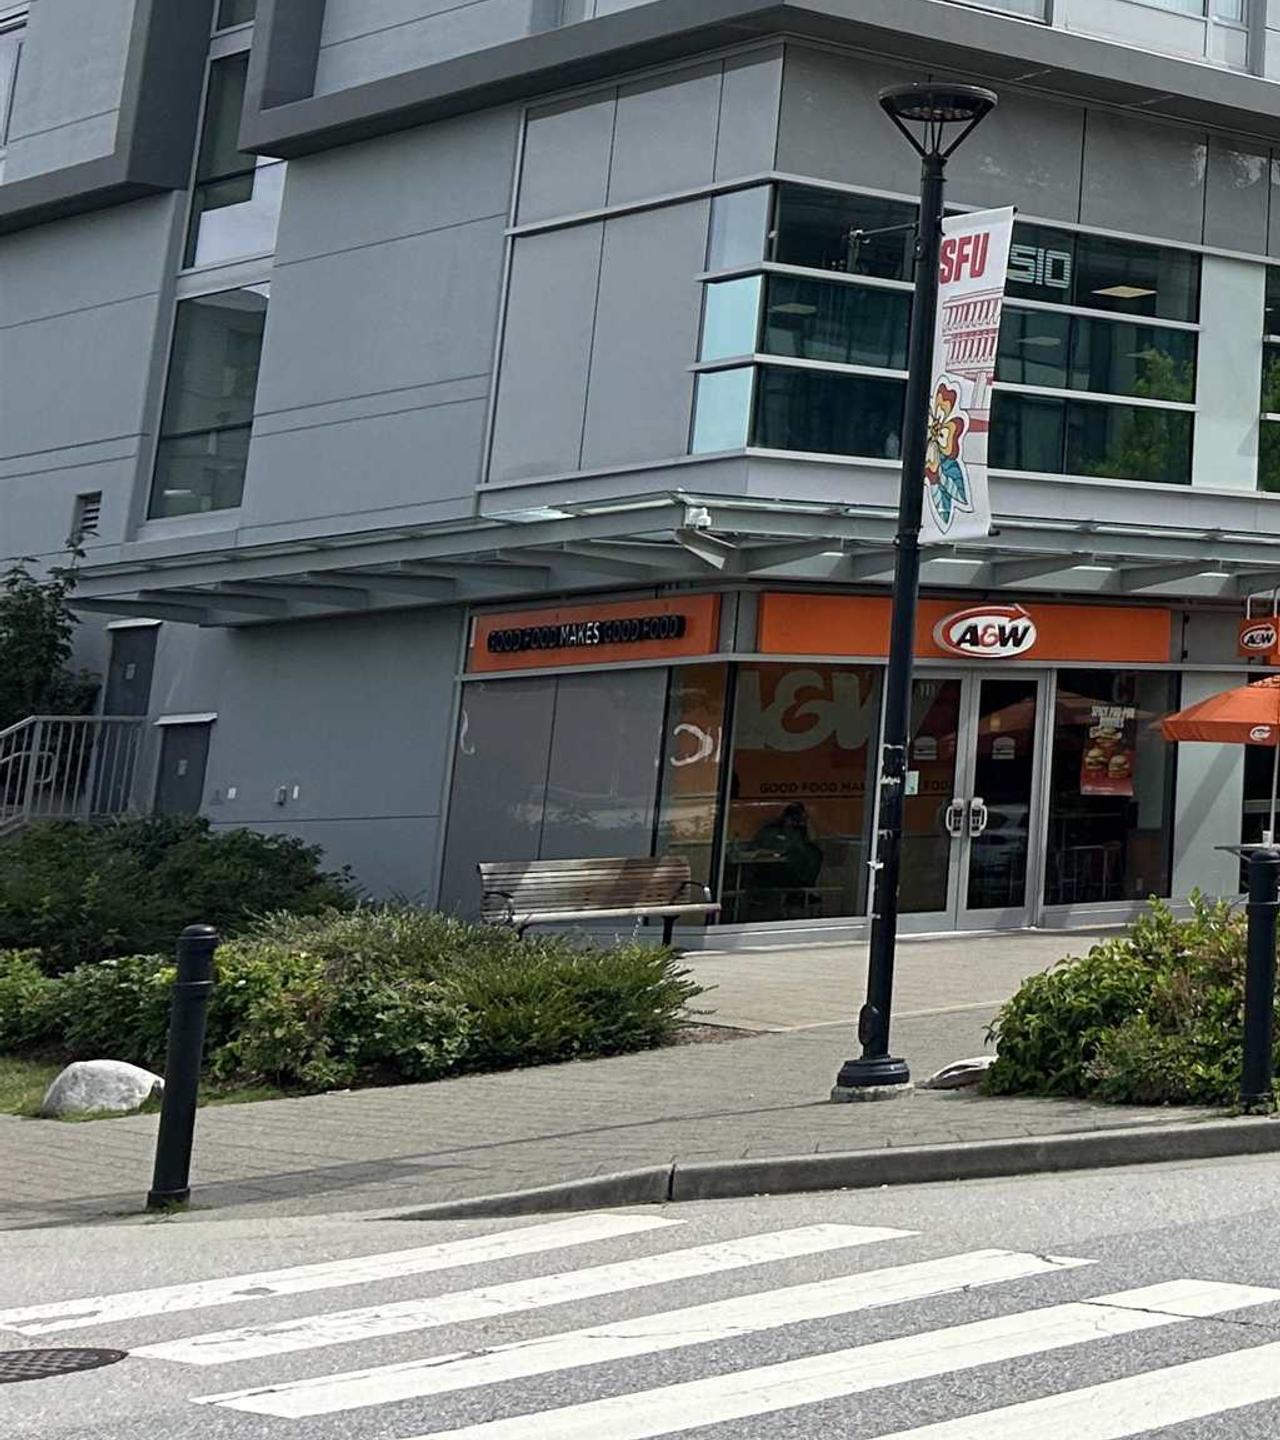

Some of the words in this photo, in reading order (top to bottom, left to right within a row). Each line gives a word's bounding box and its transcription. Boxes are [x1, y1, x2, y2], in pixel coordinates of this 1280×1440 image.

[939, 232, 990, 285] SFU
[559, 621, 600, 647] MAKES
[602, 618, 640, 644] GOOD
[641, 615, 681, 640] FOOD
[956, 623, 1031, 649] A&W
[1246, 632, 1274, 645] A&W
